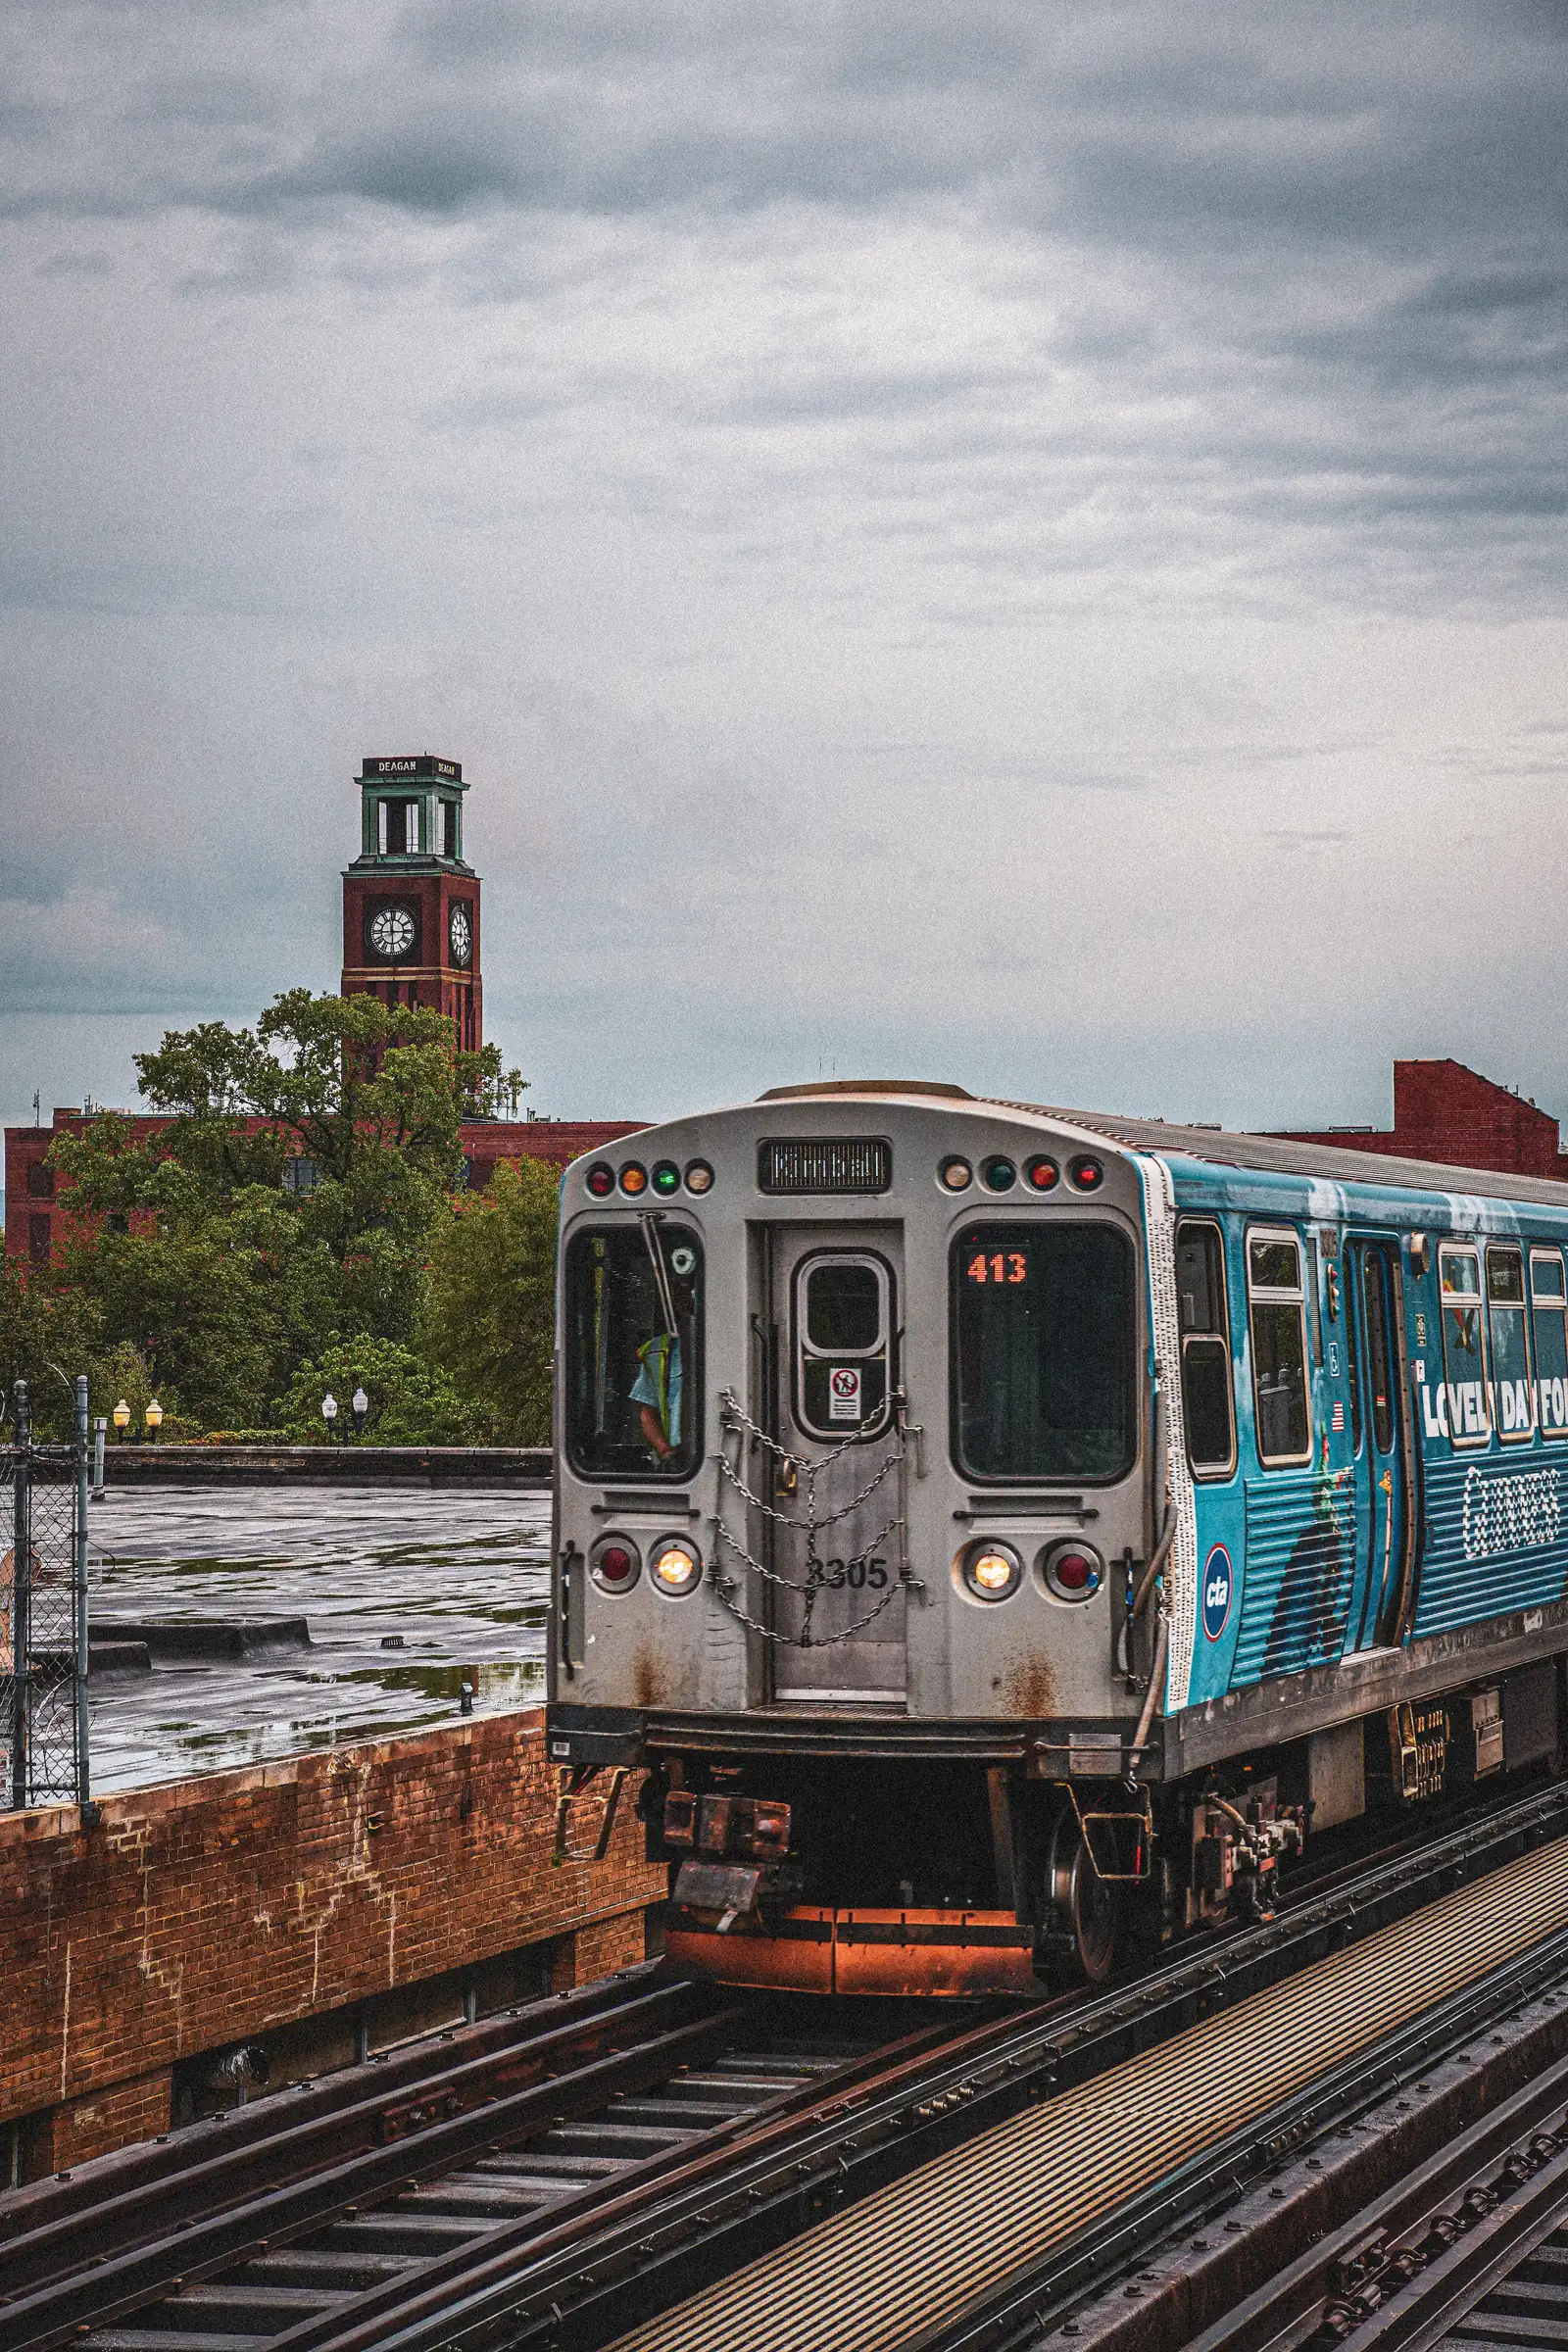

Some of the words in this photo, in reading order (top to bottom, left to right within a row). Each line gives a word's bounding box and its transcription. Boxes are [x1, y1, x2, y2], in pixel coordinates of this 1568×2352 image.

[378, 760, 416, 772] DEAGAN
[438, 762, 455, 776] DEAGAN
[775, 1152, 878, 1178] Kimball
[968, 1254, 1025, 1283] 413
[1149, 1223, 1157, 1300] GOVERNMENT
[1152, 1219, 1162, 1284] ALCOHOLIC
[1422, 1381, 1497, 1438] LOVELY
[1500, 1379, 1538, 1430] DAY
[1180, 1453, 1189, 1523] BEVERAGES
[1177, 1508, 1186, 1580] PREGNANCY
[1206, 1576, 1228, 1607] cta
